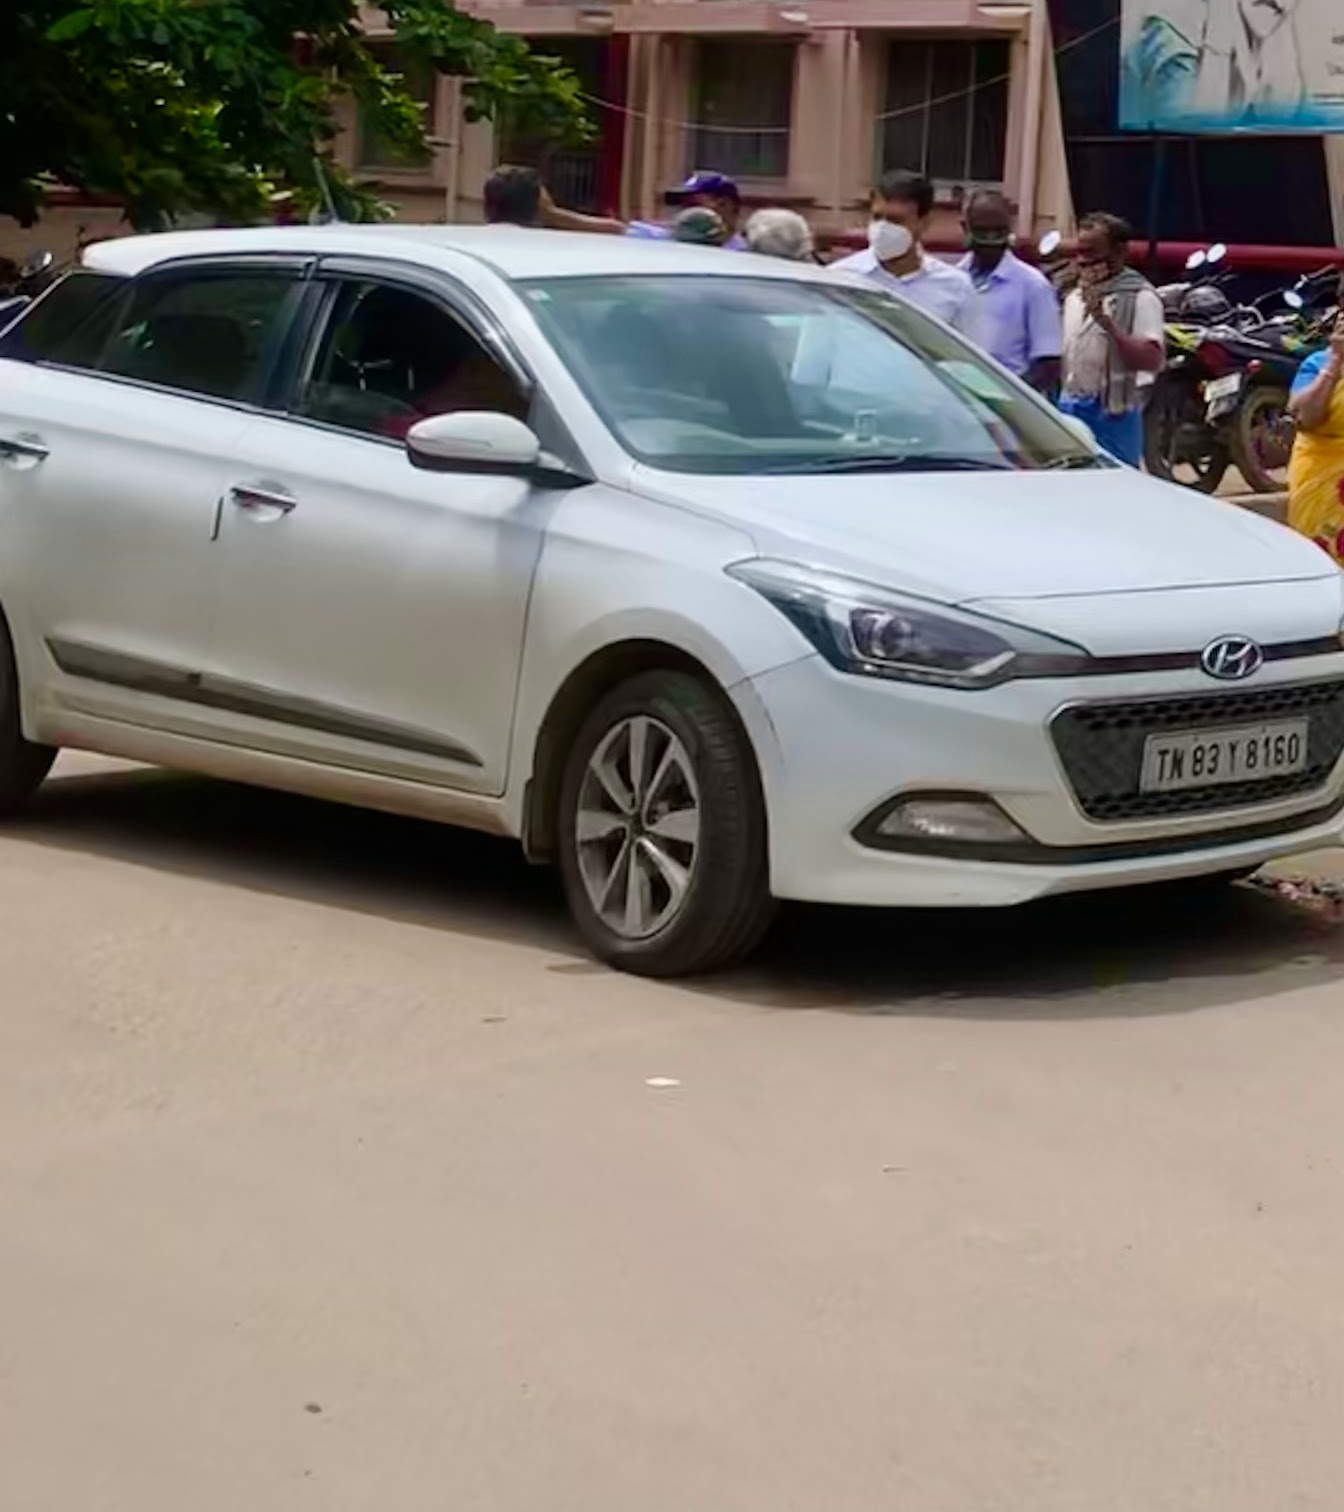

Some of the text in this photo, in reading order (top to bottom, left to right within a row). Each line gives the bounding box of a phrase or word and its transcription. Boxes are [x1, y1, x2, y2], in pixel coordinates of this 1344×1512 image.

[1156, 732, 1300, 782] TN 83 Y 8160
